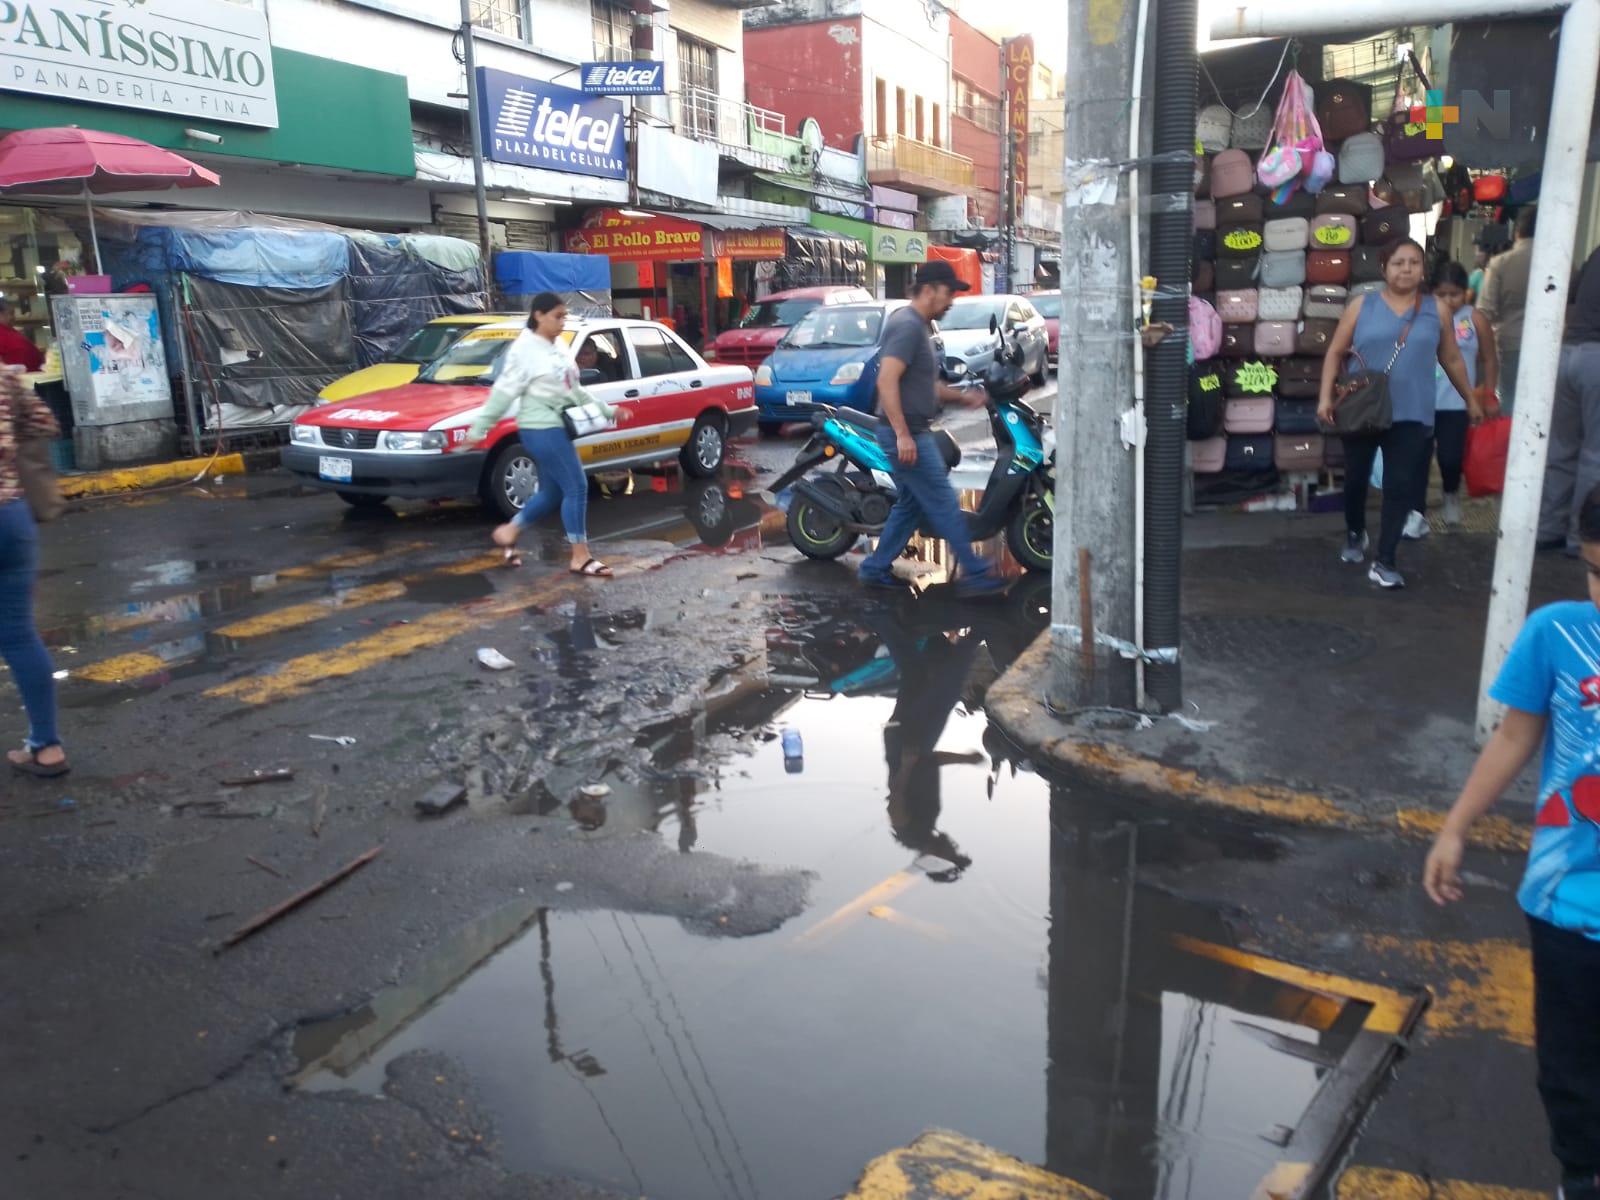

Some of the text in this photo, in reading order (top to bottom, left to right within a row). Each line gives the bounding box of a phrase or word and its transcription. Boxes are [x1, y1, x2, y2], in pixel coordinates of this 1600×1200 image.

[1010, 44, 1032, 64] LA
[605, 66, 660, 85] telcel
[14, 65, 250, 116] PANADERÍA FINA
[533, 97, 620, 154] telcel
[496, 138, 623, 170] PLAZA DEL CELULAR
[592, 230, 701, 248] El Pollo Bravo
